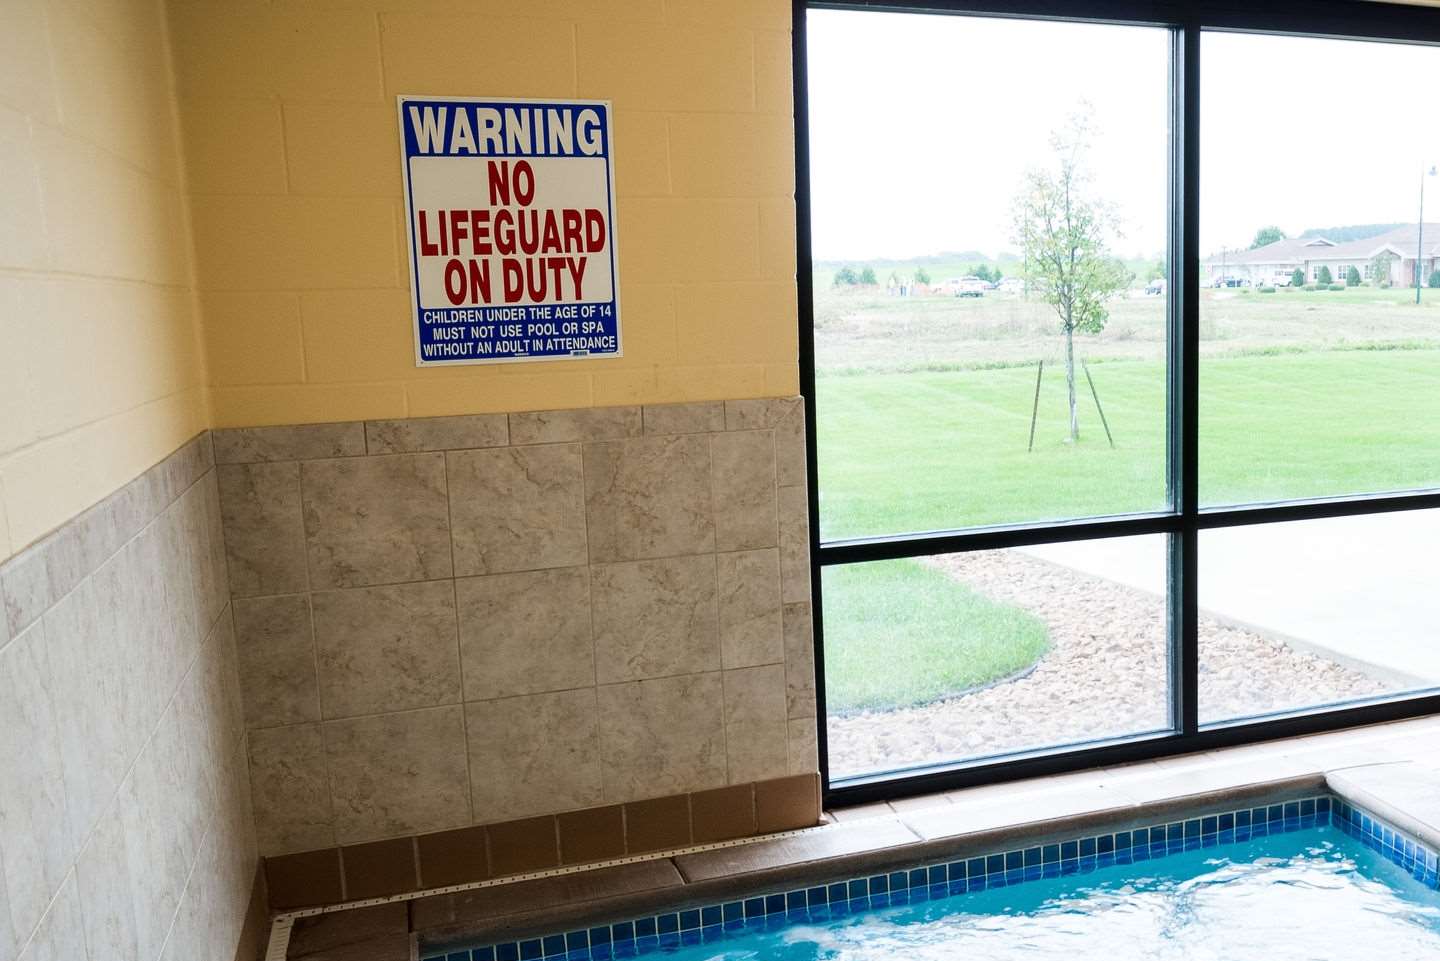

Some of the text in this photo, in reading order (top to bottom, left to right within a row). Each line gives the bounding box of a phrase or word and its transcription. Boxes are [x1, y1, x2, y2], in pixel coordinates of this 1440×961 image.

[409, 106, 604, 156] WARNING
[487, 160, 535, 206] NO
[418, 209, 606, 256] LIFEGUARD
[444, 257, 587, 306] ON DUTY
[423, 305, 611, 324] CHILDREN UNDER THE AGE OF 14
[433, 321, 604, 341] MUST NOT USE POOL OR SPA
[423, 335, 616, 357] WITHOUT AN ADULT IN ATTENDANCE
